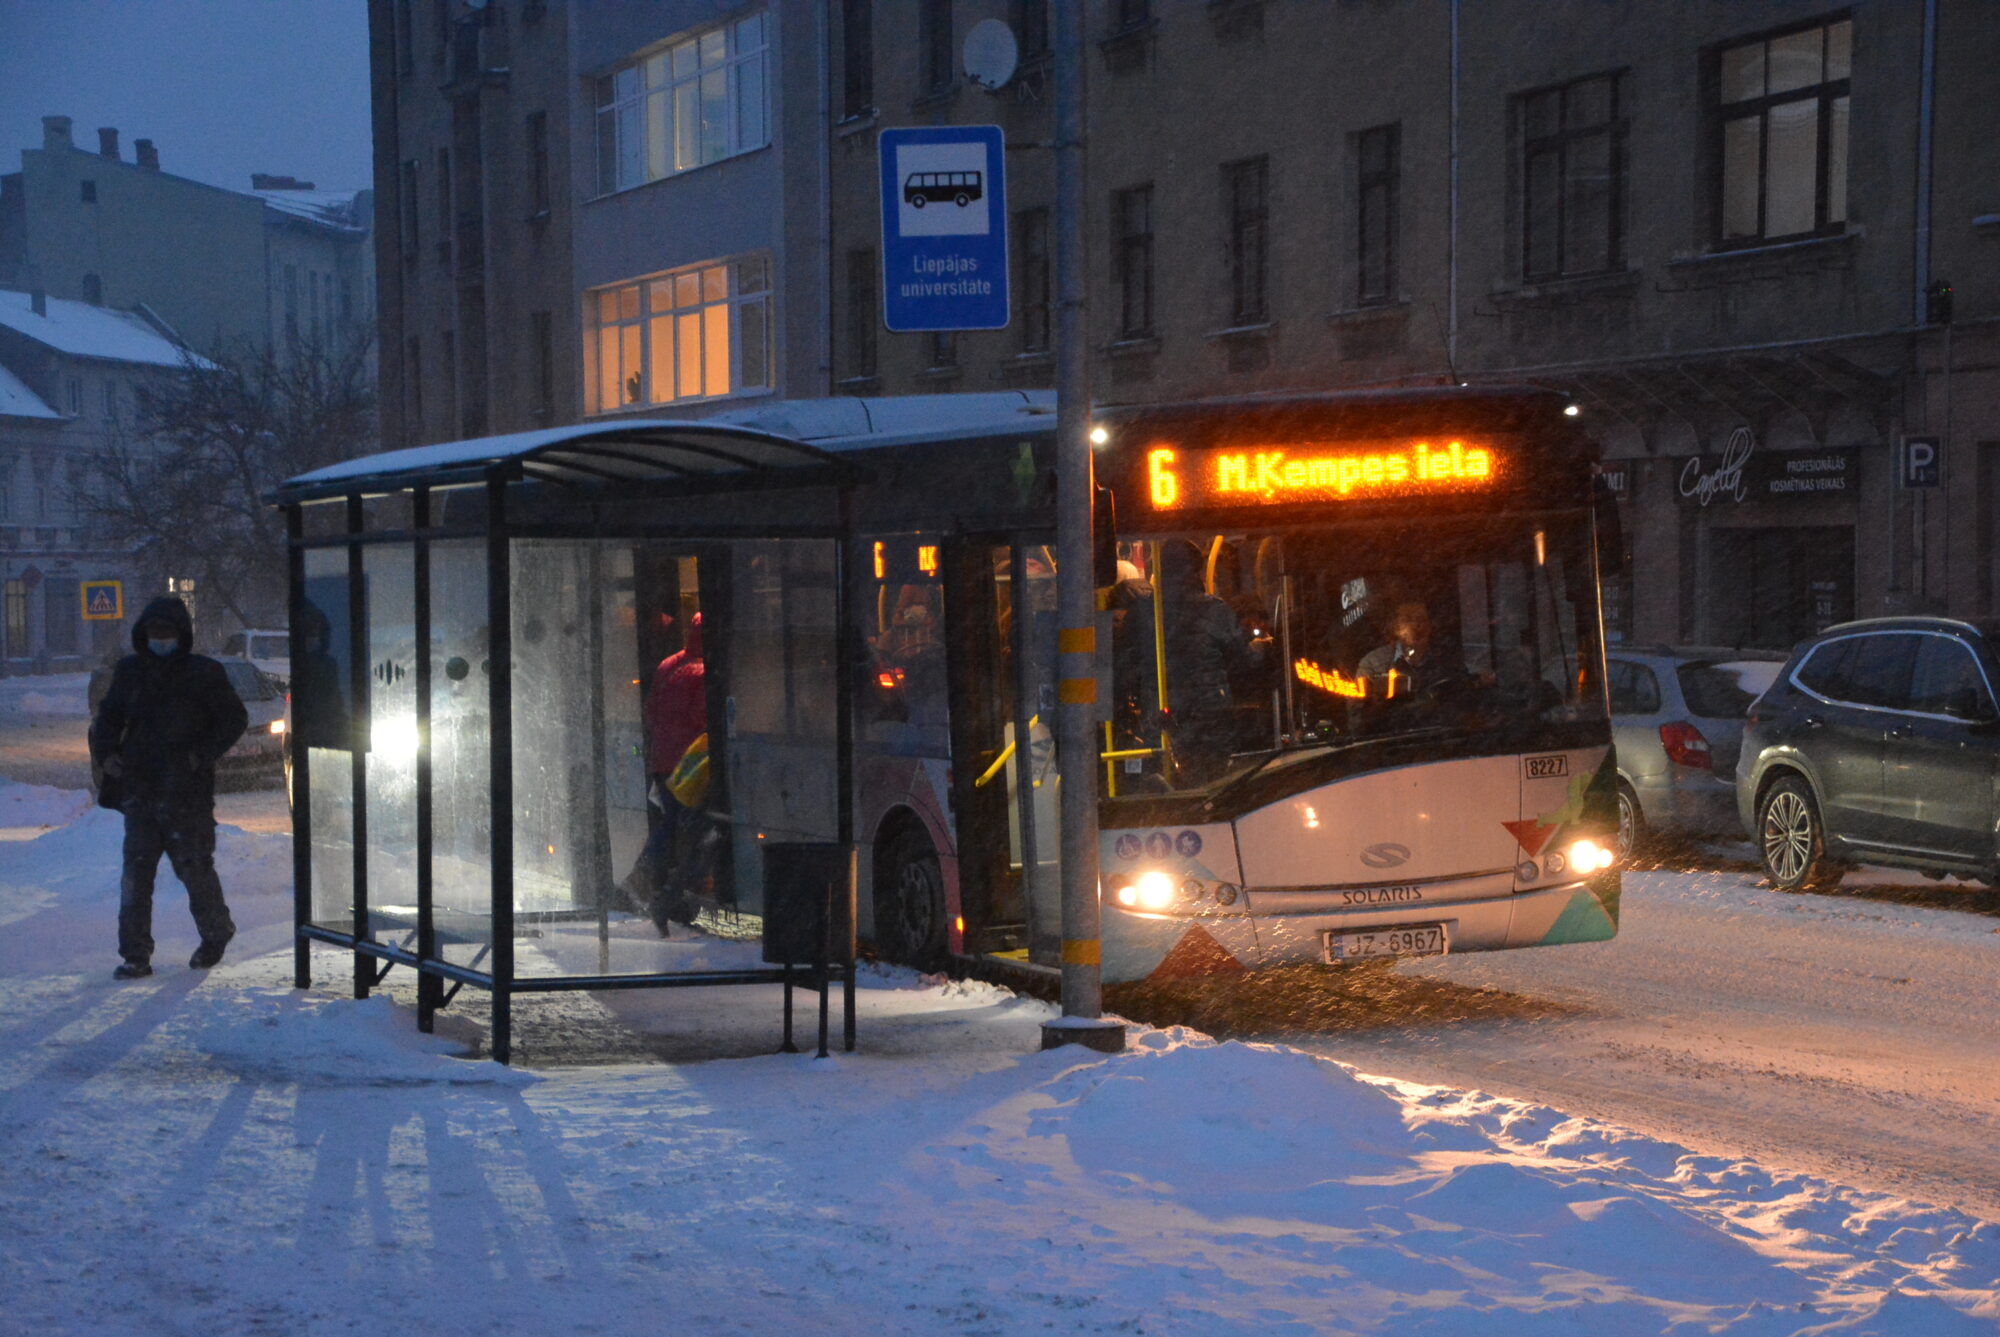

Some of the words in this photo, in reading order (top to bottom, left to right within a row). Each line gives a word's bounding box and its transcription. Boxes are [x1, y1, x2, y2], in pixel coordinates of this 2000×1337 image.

[913, 254, 977, 276] Liepājas
[901, 279, 991, 297] universitāte
[1910, 443, 1934, 480] P
[1149, 448, 1177, 507] 6
[1415, 441, 1491, 481] iela
[874, 540, 886, 579] 6
[1530, 758, 1565, 777] 8227
[1342, 886, 1422, 906] SOLARIS
